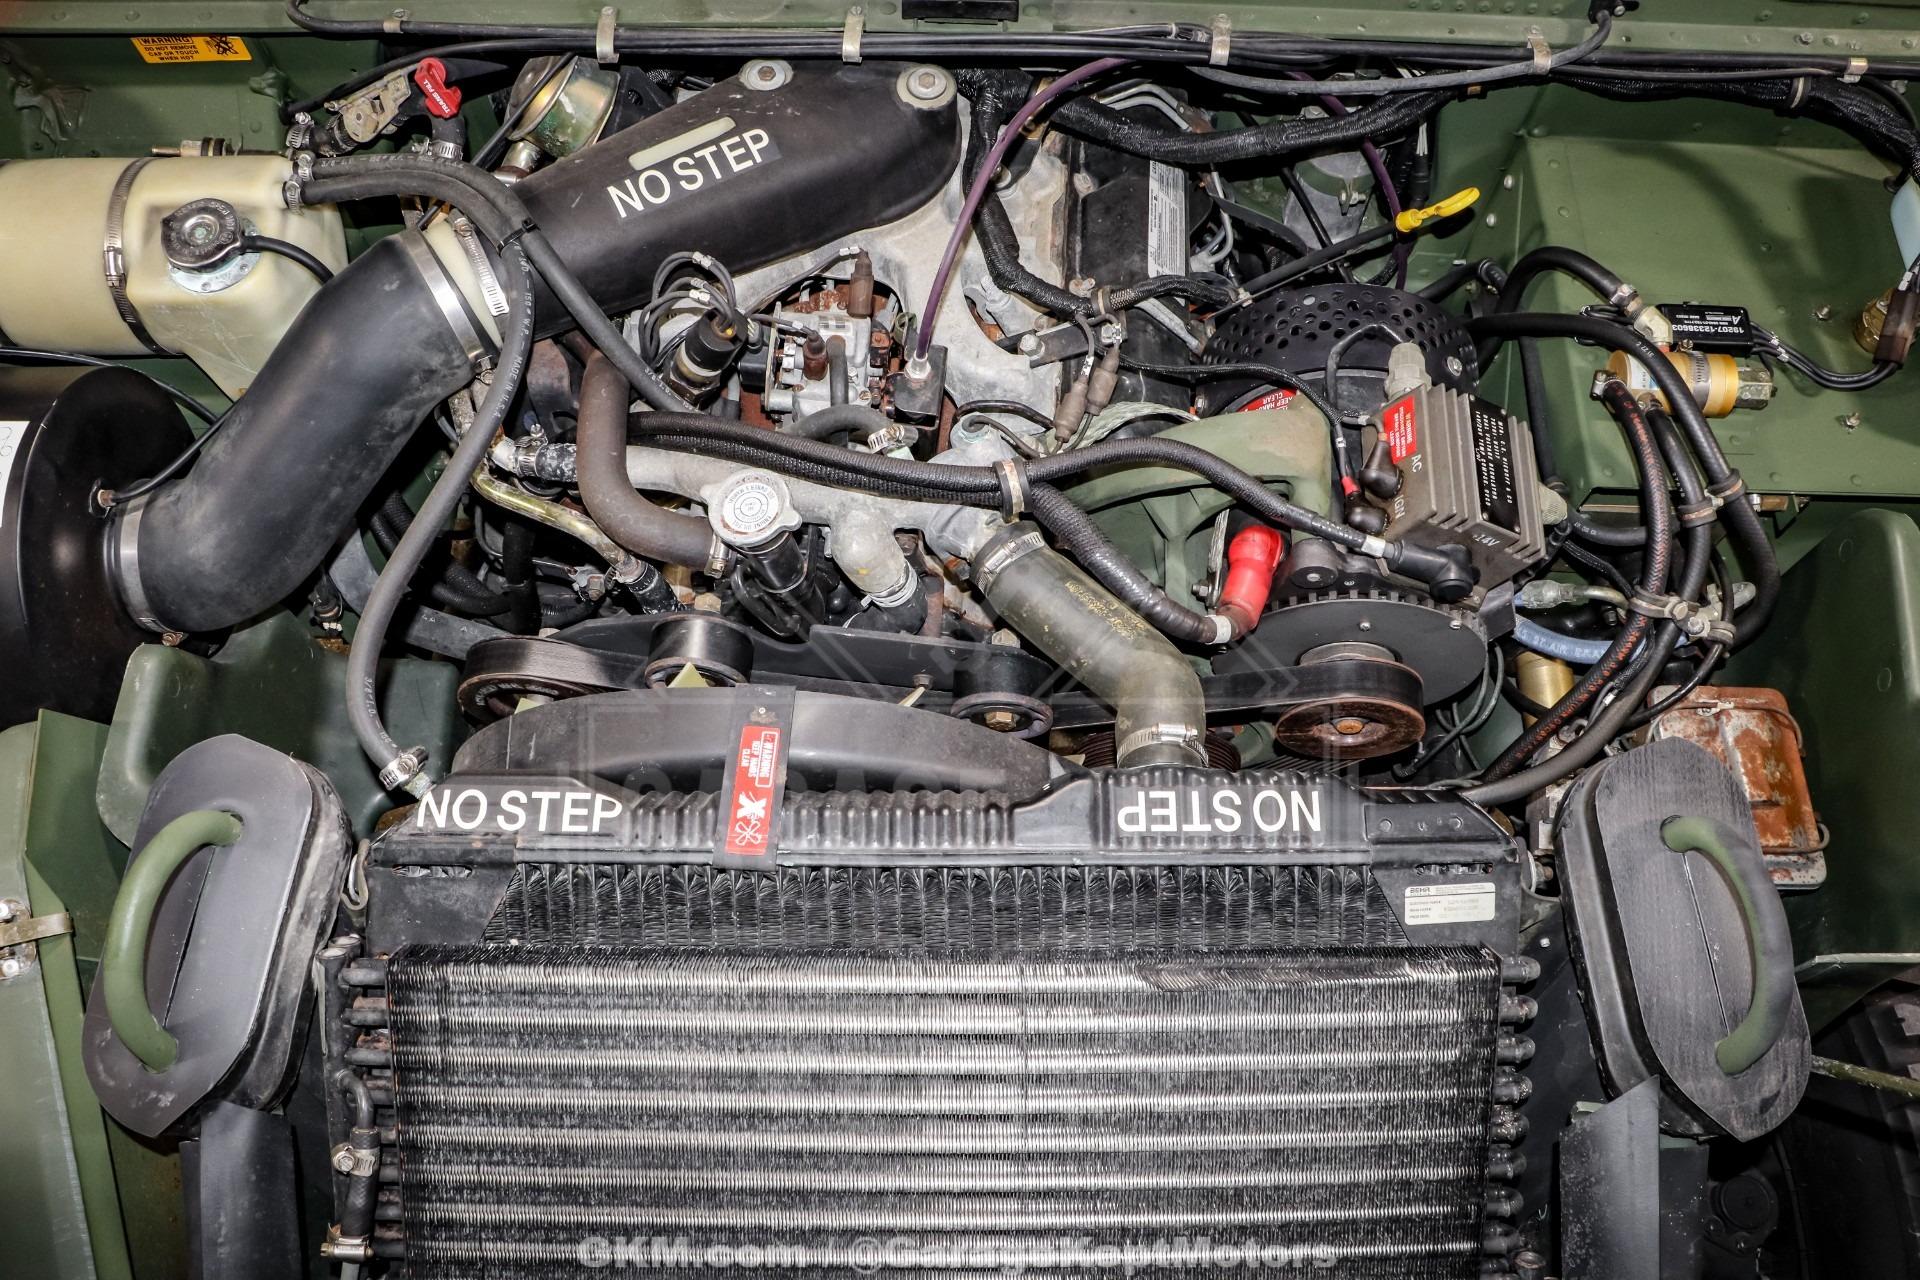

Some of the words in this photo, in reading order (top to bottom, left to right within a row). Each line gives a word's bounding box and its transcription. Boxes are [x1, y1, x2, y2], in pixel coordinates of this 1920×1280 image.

[141, 36, 190, 44] WARNING
[424, 78, 435, 92] FILL
[432, 92, 450, 113] TRANS
[607, 170, 671, 218] NO
[673, 128, 770, 191] STEP
[510, 355, 522, 380] MADE
[1263, 392, 1283, 404] CLEAR
[1412, 454, 1422, 472] AC
[1394, 495, 1405, 519] IGN
[741, 749, 751, 767] CLEAR
[760, 742, 773, 777] WARNING
[417, 789, 488, 830] NO
[496, 789, 623, 832] STEP
[1117, 789, 1241, 832] STEP
[1253, 789, 1321, 832] NO
